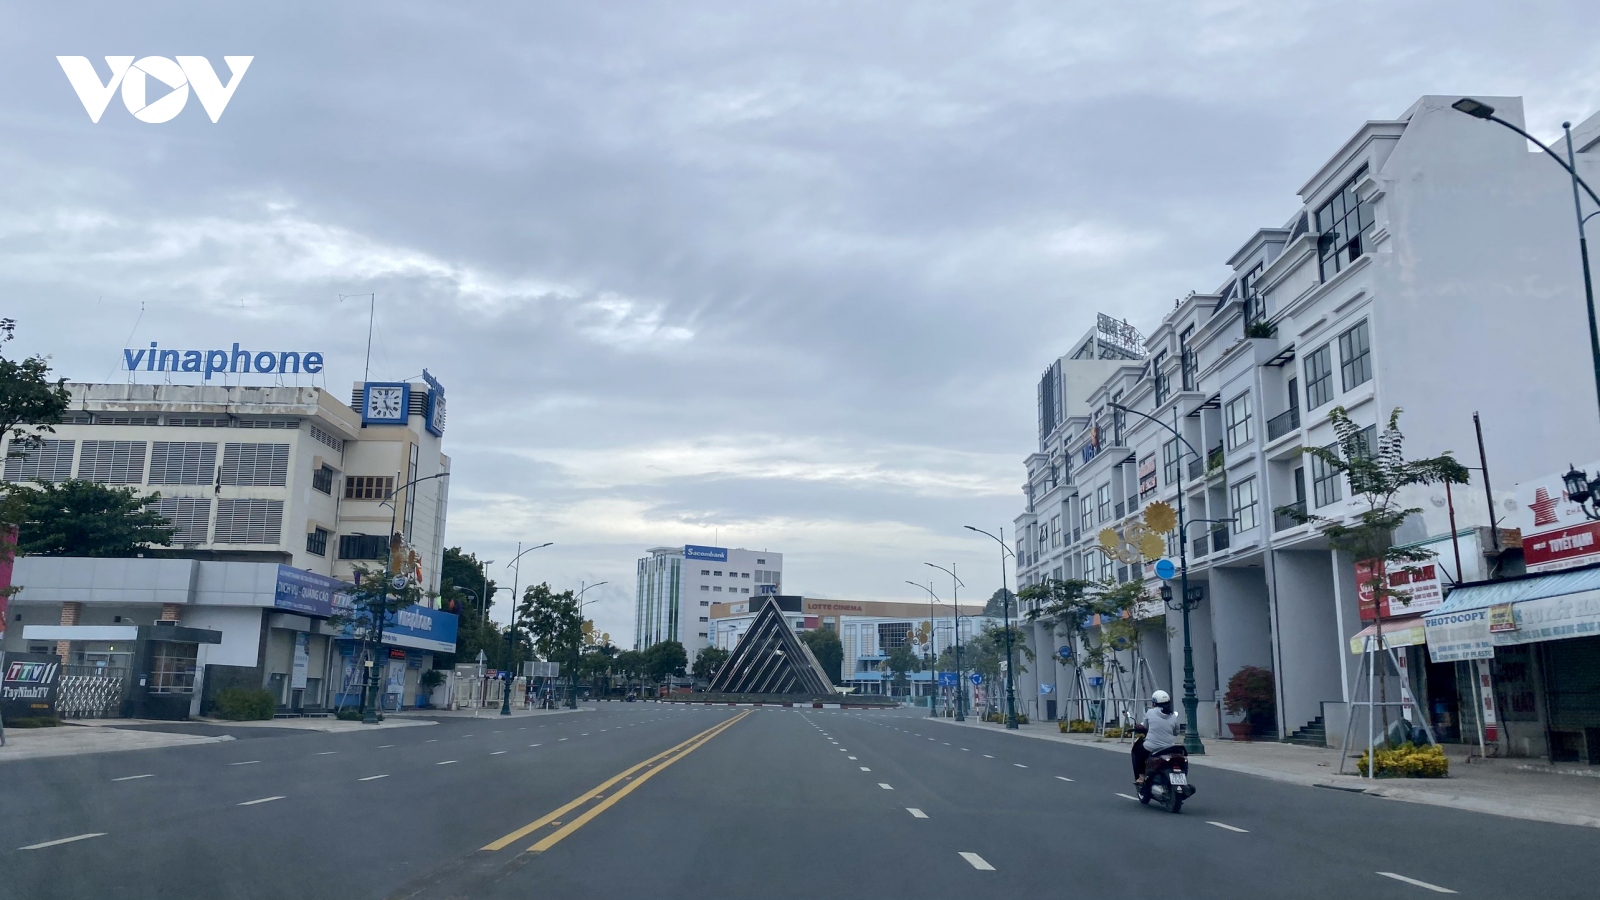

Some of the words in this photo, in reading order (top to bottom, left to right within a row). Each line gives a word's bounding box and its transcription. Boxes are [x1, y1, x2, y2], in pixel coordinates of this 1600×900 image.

[124, 342, 324, 379] vinaphone
[688, 548, 725, 559] Sacombank
[760, 584, 777, 594] TTC
[807, 603, 832, 611] LOTTE
[833, 604, 862, 612] CINEMA
[1425, 611, 1486, 627] PHOTOCOPY
[3, 686, 49, 700] TayNinhTV
